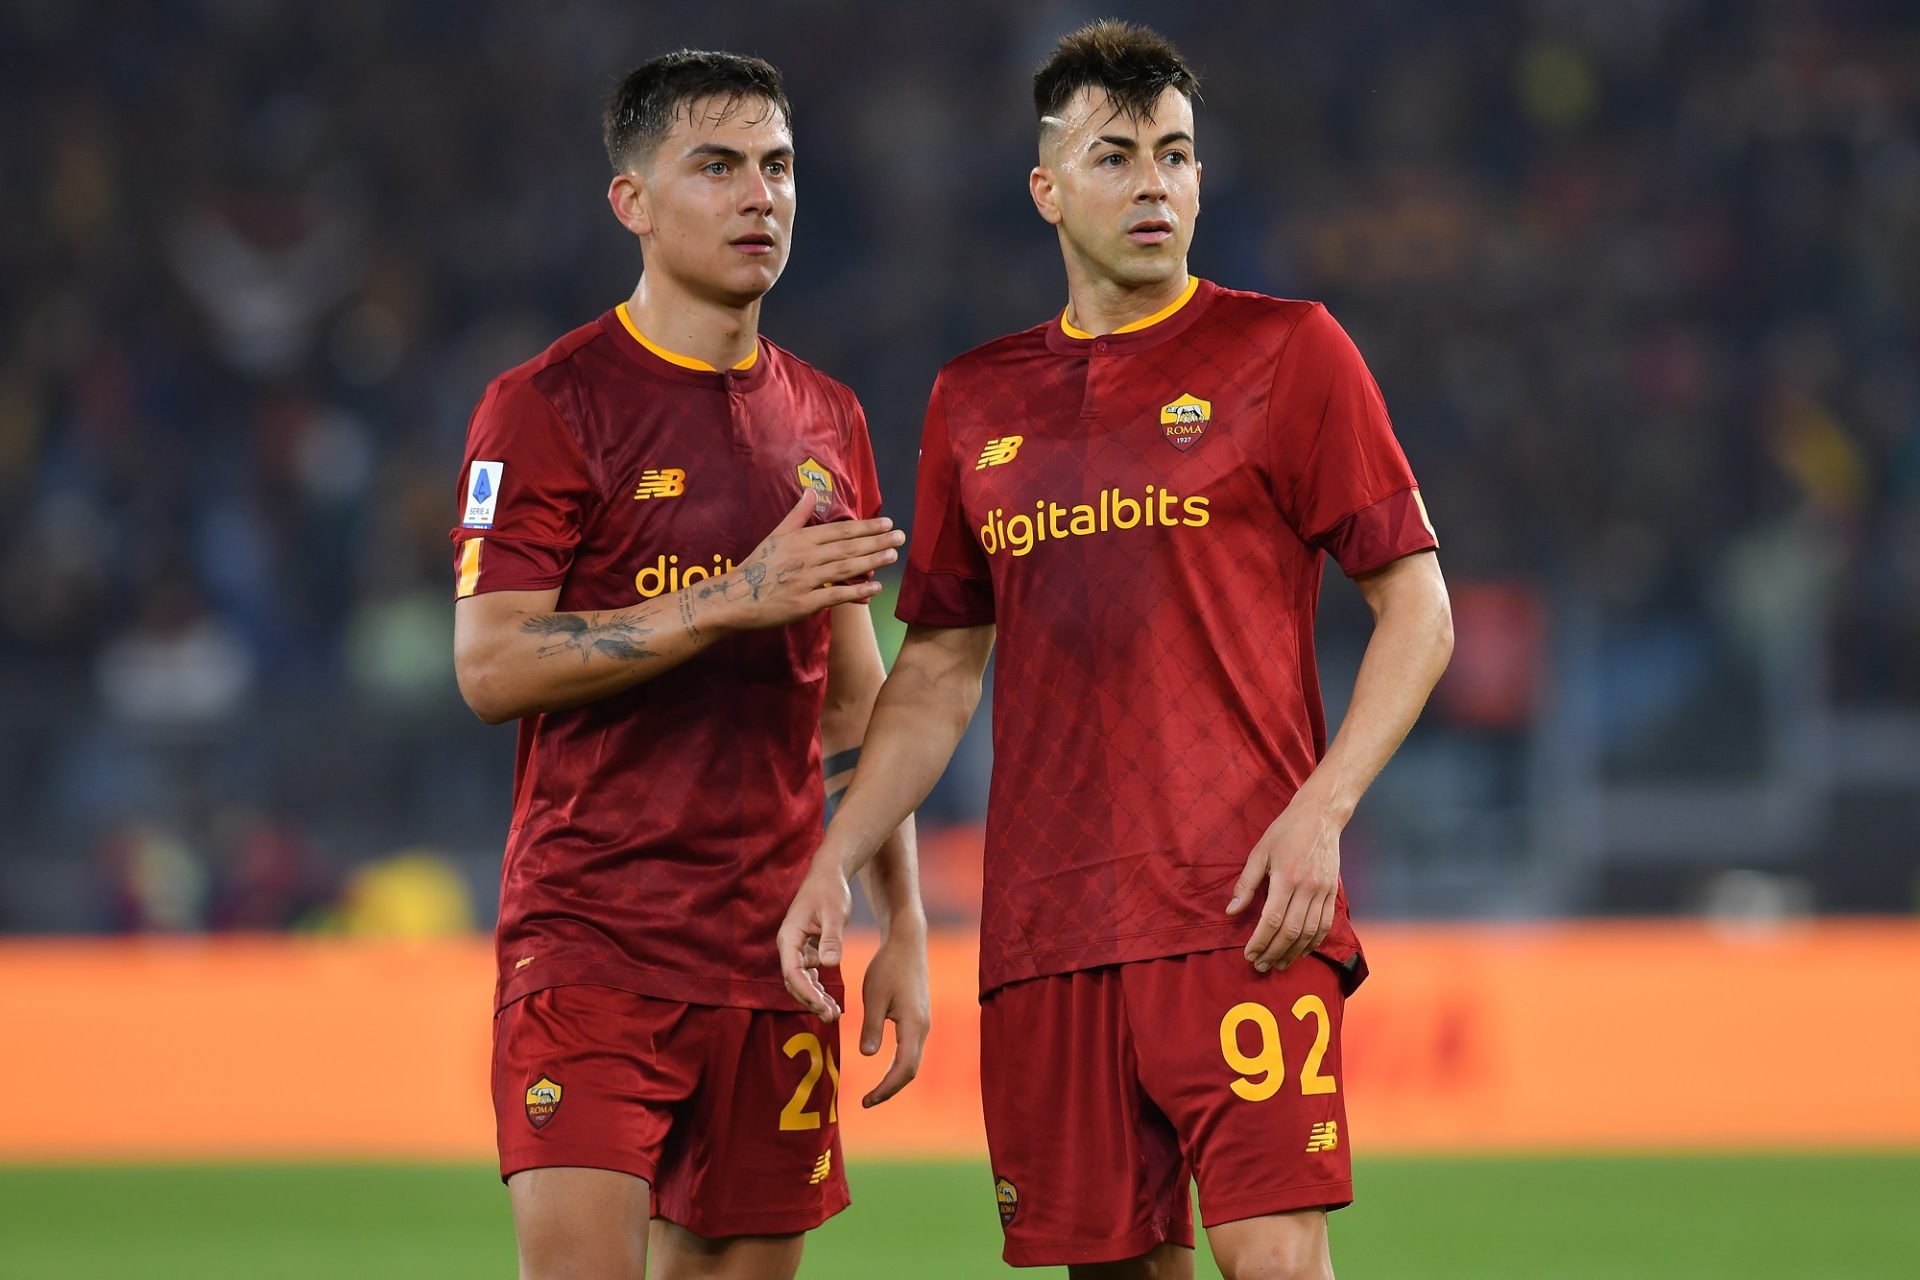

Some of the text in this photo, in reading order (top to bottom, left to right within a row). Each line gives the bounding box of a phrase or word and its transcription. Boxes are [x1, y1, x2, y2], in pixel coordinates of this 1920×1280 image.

[1166, 424, 1202, 436] ROMA
[469, 507, 485, 515] SERIE
[980, 484, 1210, 557] digitalbits
[1219, 994, 1337, 1102] 92
[530, 1105, 554, 1115] ROMA
